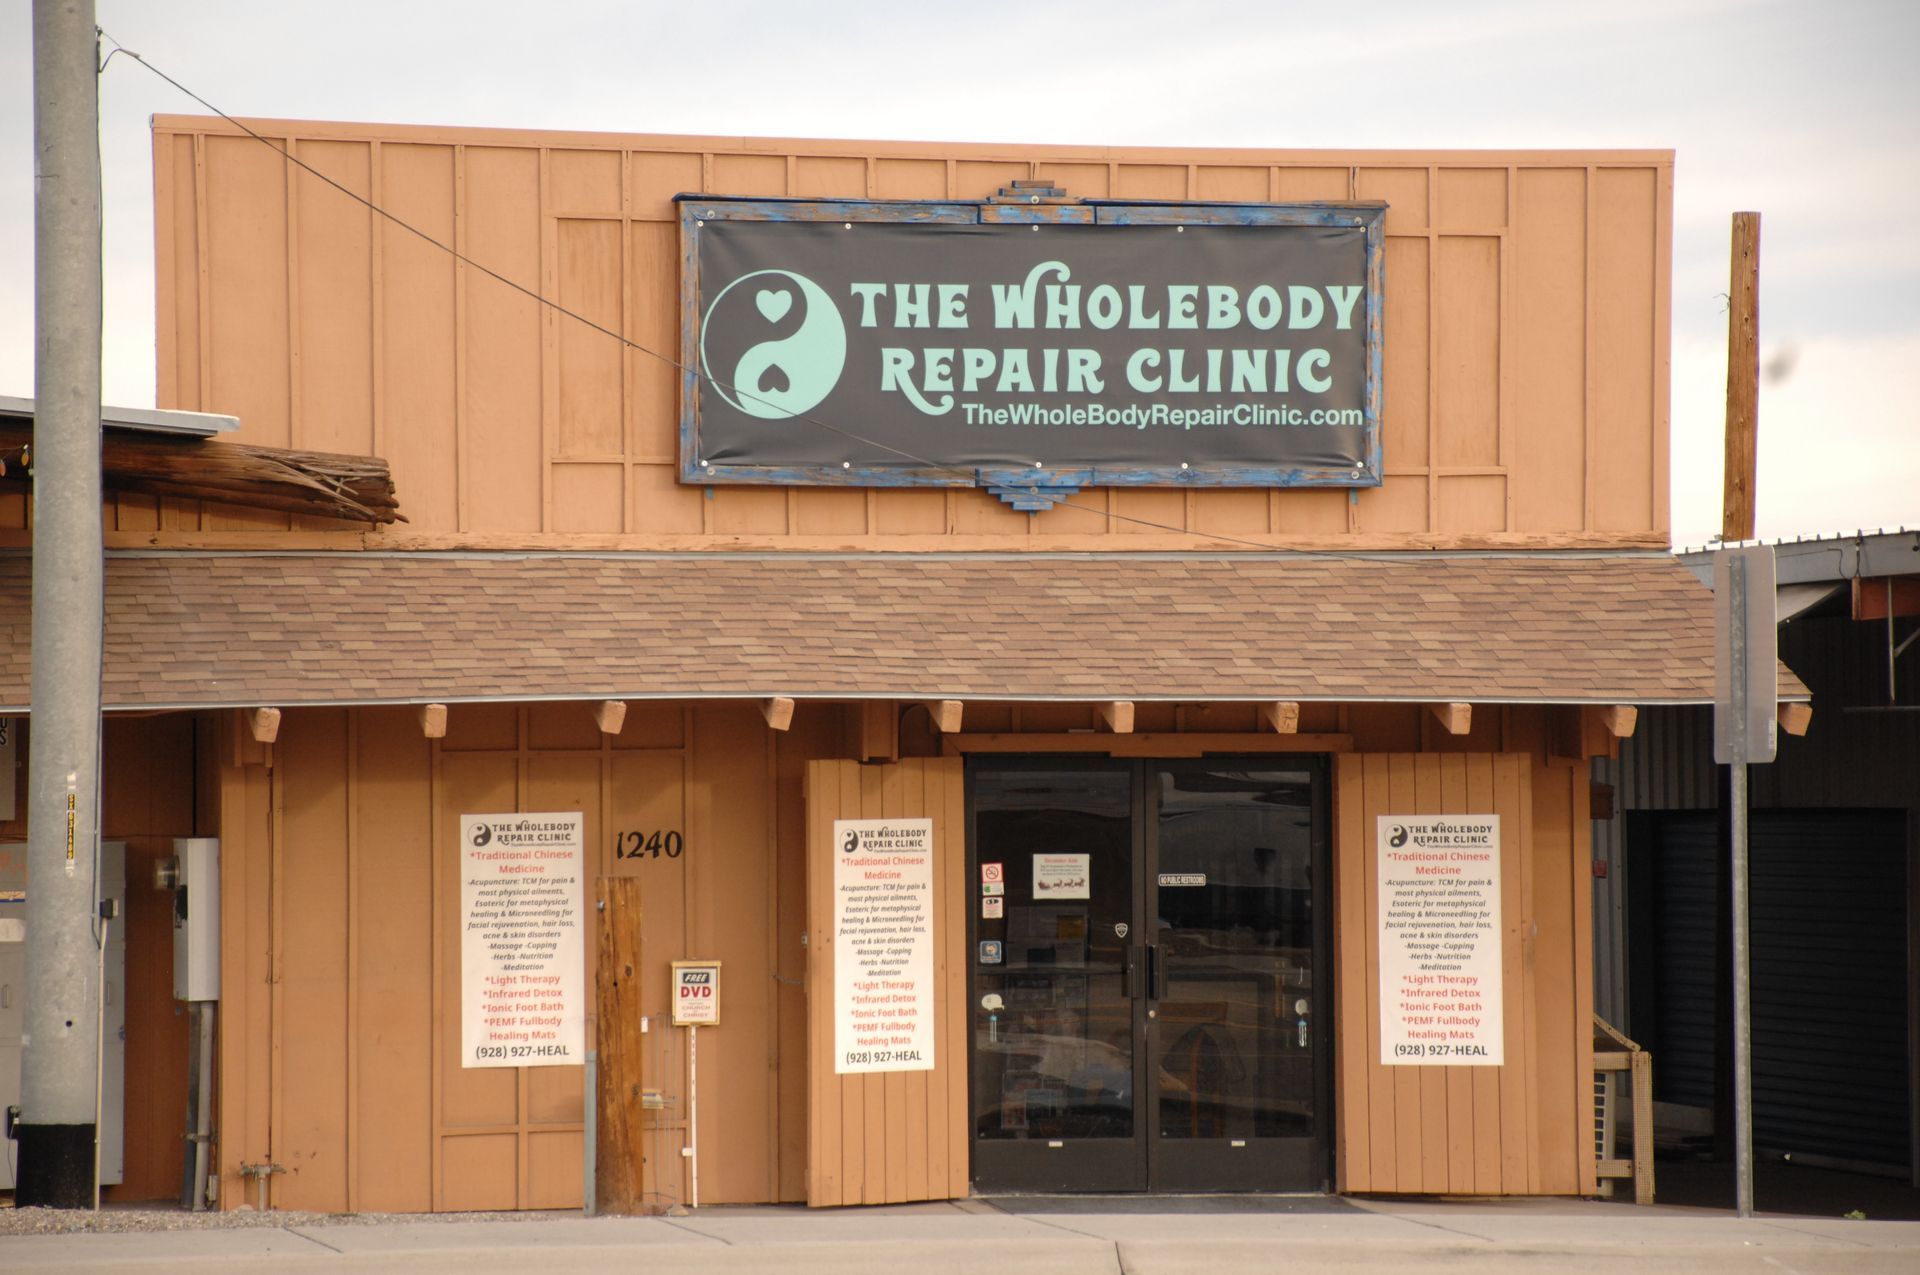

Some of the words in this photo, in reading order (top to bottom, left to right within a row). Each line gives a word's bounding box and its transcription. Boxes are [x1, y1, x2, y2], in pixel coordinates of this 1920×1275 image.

[851, 283, 969, 328] THE
[991, 260, 1364, 330] WHOLEBODY
[881, 348, 1105, 416] REPAIR
[1126, 348, 1334, 393] CLINIC
[962, 404, 1363, 430] TheWholeBodyRepairClinic.com
[515, 819, 576, 831] WHOLEBODY
[1432, 822, 1492, 833] WHOLEBODY
[497, 834, 533, 845] REPAIR
[617, 830, 683, 859] 1240
[1414, 836, 1449, 847] REPAIR
[534, 850, 573, 858] Chinese
[499, 865, 545, 873] Medicine
[498, 889, 529, 897] physical
[519, 899, 569, 907] metaphysical
[508, 910, 560, 918] Microneedling
[524, 942, 557, 950] -Cupping
[519, 975, 561, 985] Therapy
[685, 974, 708, 982] FREE
[1437, 975, 1478, 985] Therapy
[533, 989, 563, 997] Detox
[681, 986, 711, 998] DVD
[1451, 989, 1480, 997] Detox
[515, 1003, 537, 1011] Foot
[540, 1003, 564, 1011] Bath
[1433, 1003, 1455, 1011] Foot
[1458, 1003, 1482, 1011] Bath
[519, 1017, 562, 1027] Fullbody
[1437, 1017, 1480, 1026] Fullbody
[489, 1031, 529, 1042] Healing
[531, 1031, 557, 1039] Mats
[1408, 1031, 1446, 1040] Healing
[476, 1045, 507, 1059] (928)
[511, 1045, 570, 1057] 927-HEAL
[1395, 1044, 1425, 1057] (928)
[1429, 1045, 1488, 1055] 927-HEAL
